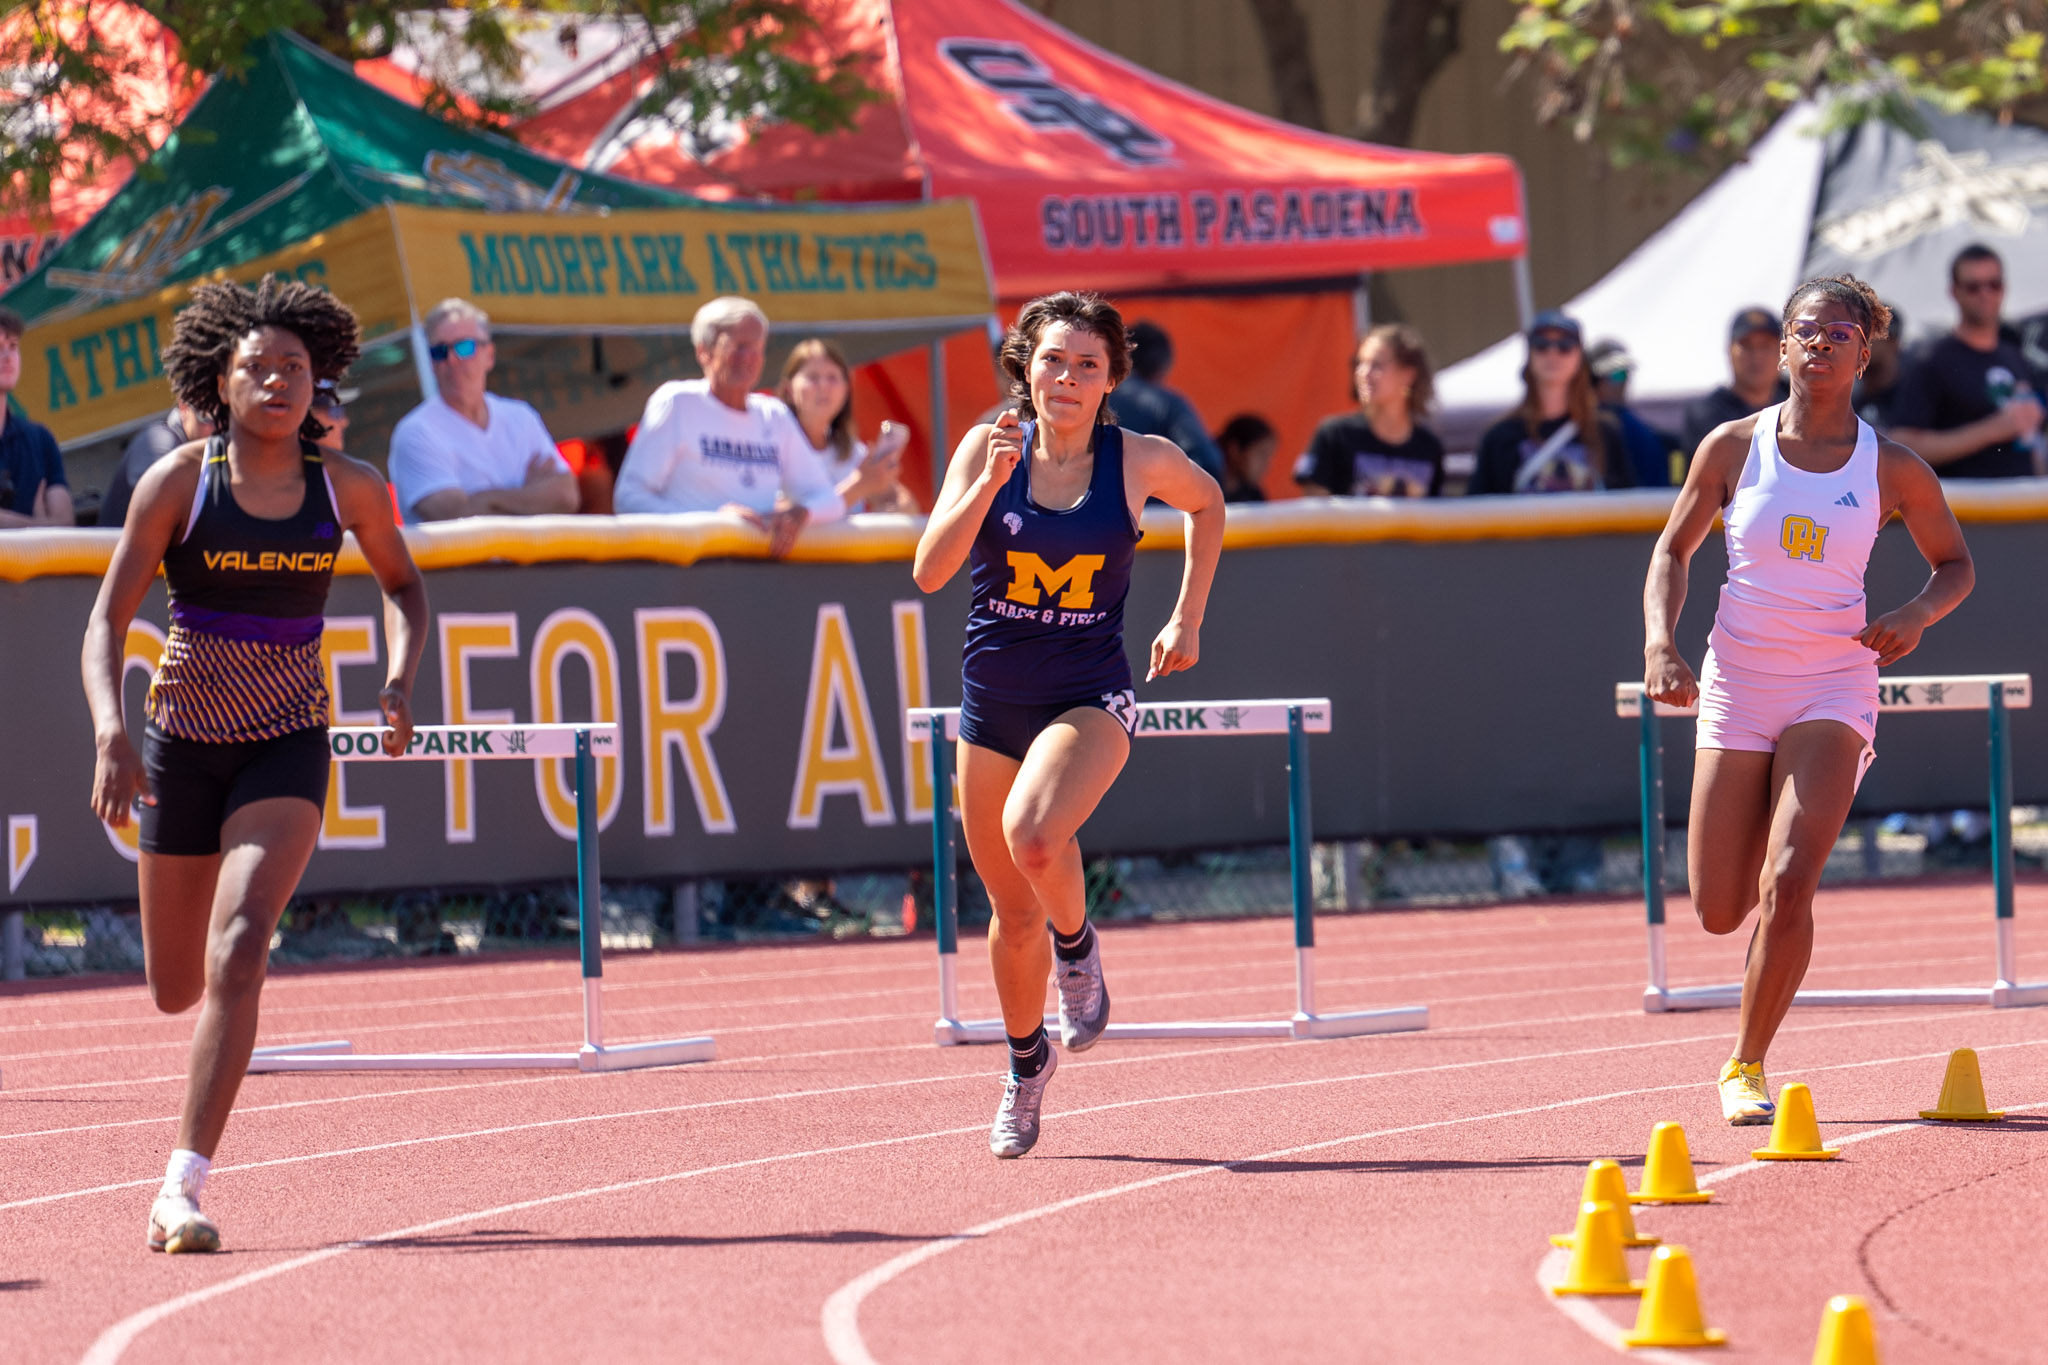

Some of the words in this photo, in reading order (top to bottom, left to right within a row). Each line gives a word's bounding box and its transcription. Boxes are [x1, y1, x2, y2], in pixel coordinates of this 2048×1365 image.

[1042, 193, 1182, 248] SOUTH
[1190, 187, 1424, 242] PASADENA
[459, 231, 697, 296] MOORPARK
[706, 230, 937, 294] ATHLETICS
[203, 551, 333, 572] VALENCIA
[1005, 550, 1106, 609] M
[988, 598, 1039, 620] TRACK
[1041, 609, 1055, 624] &
[437, 606, 737, 844] FOR
